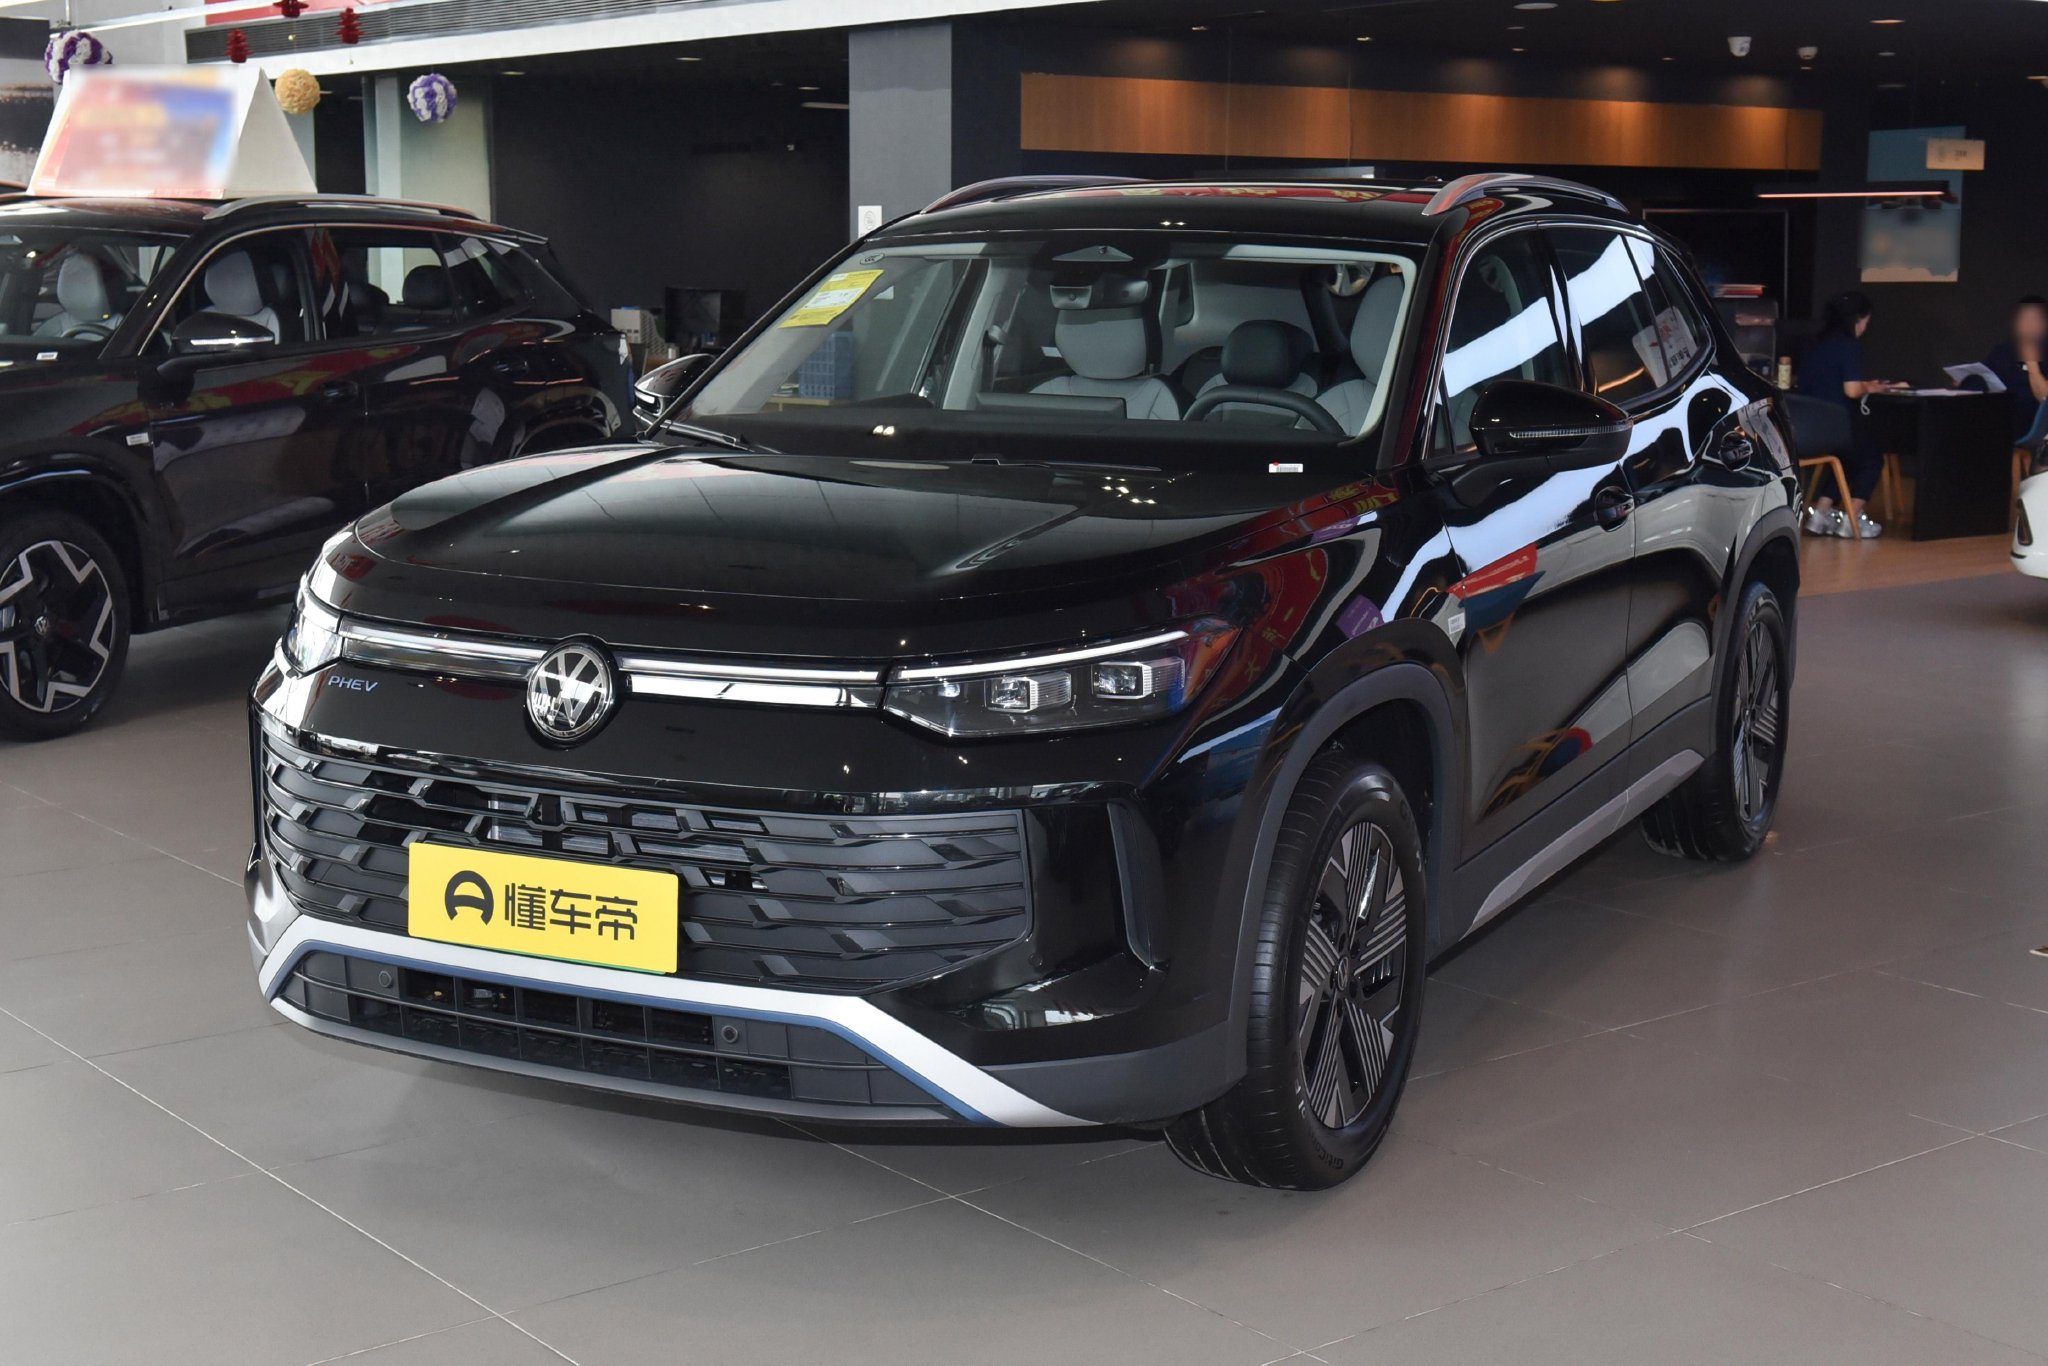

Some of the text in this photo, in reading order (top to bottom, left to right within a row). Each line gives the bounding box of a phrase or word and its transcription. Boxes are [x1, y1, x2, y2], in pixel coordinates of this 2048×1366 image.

[328, 675, 378, 691] PHEV
[531, 647, 608, 737] VW
[504, 882, 638, 940] 懂车帝
